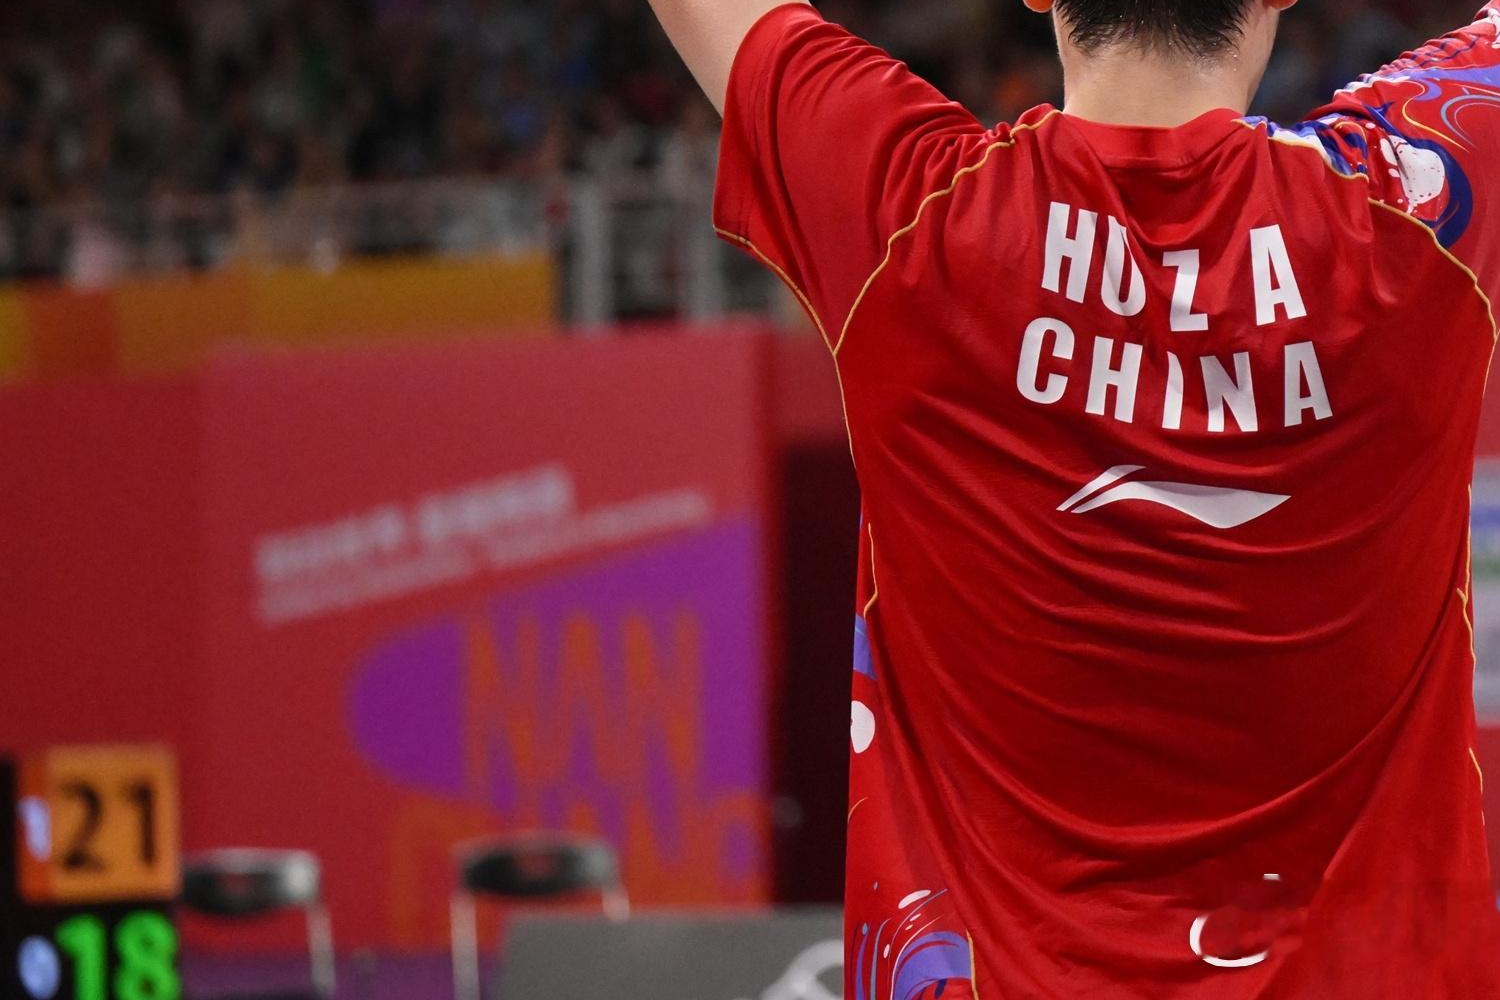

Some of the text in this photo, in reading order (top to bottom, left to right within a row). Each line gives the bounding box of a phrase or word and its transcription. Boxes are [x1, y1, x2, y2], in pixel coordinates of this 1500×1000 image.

[1016, 317, 1333, 433] CHINA
[58, 778, 156, 873] 21
[55, 910, 182, 1000] 18
